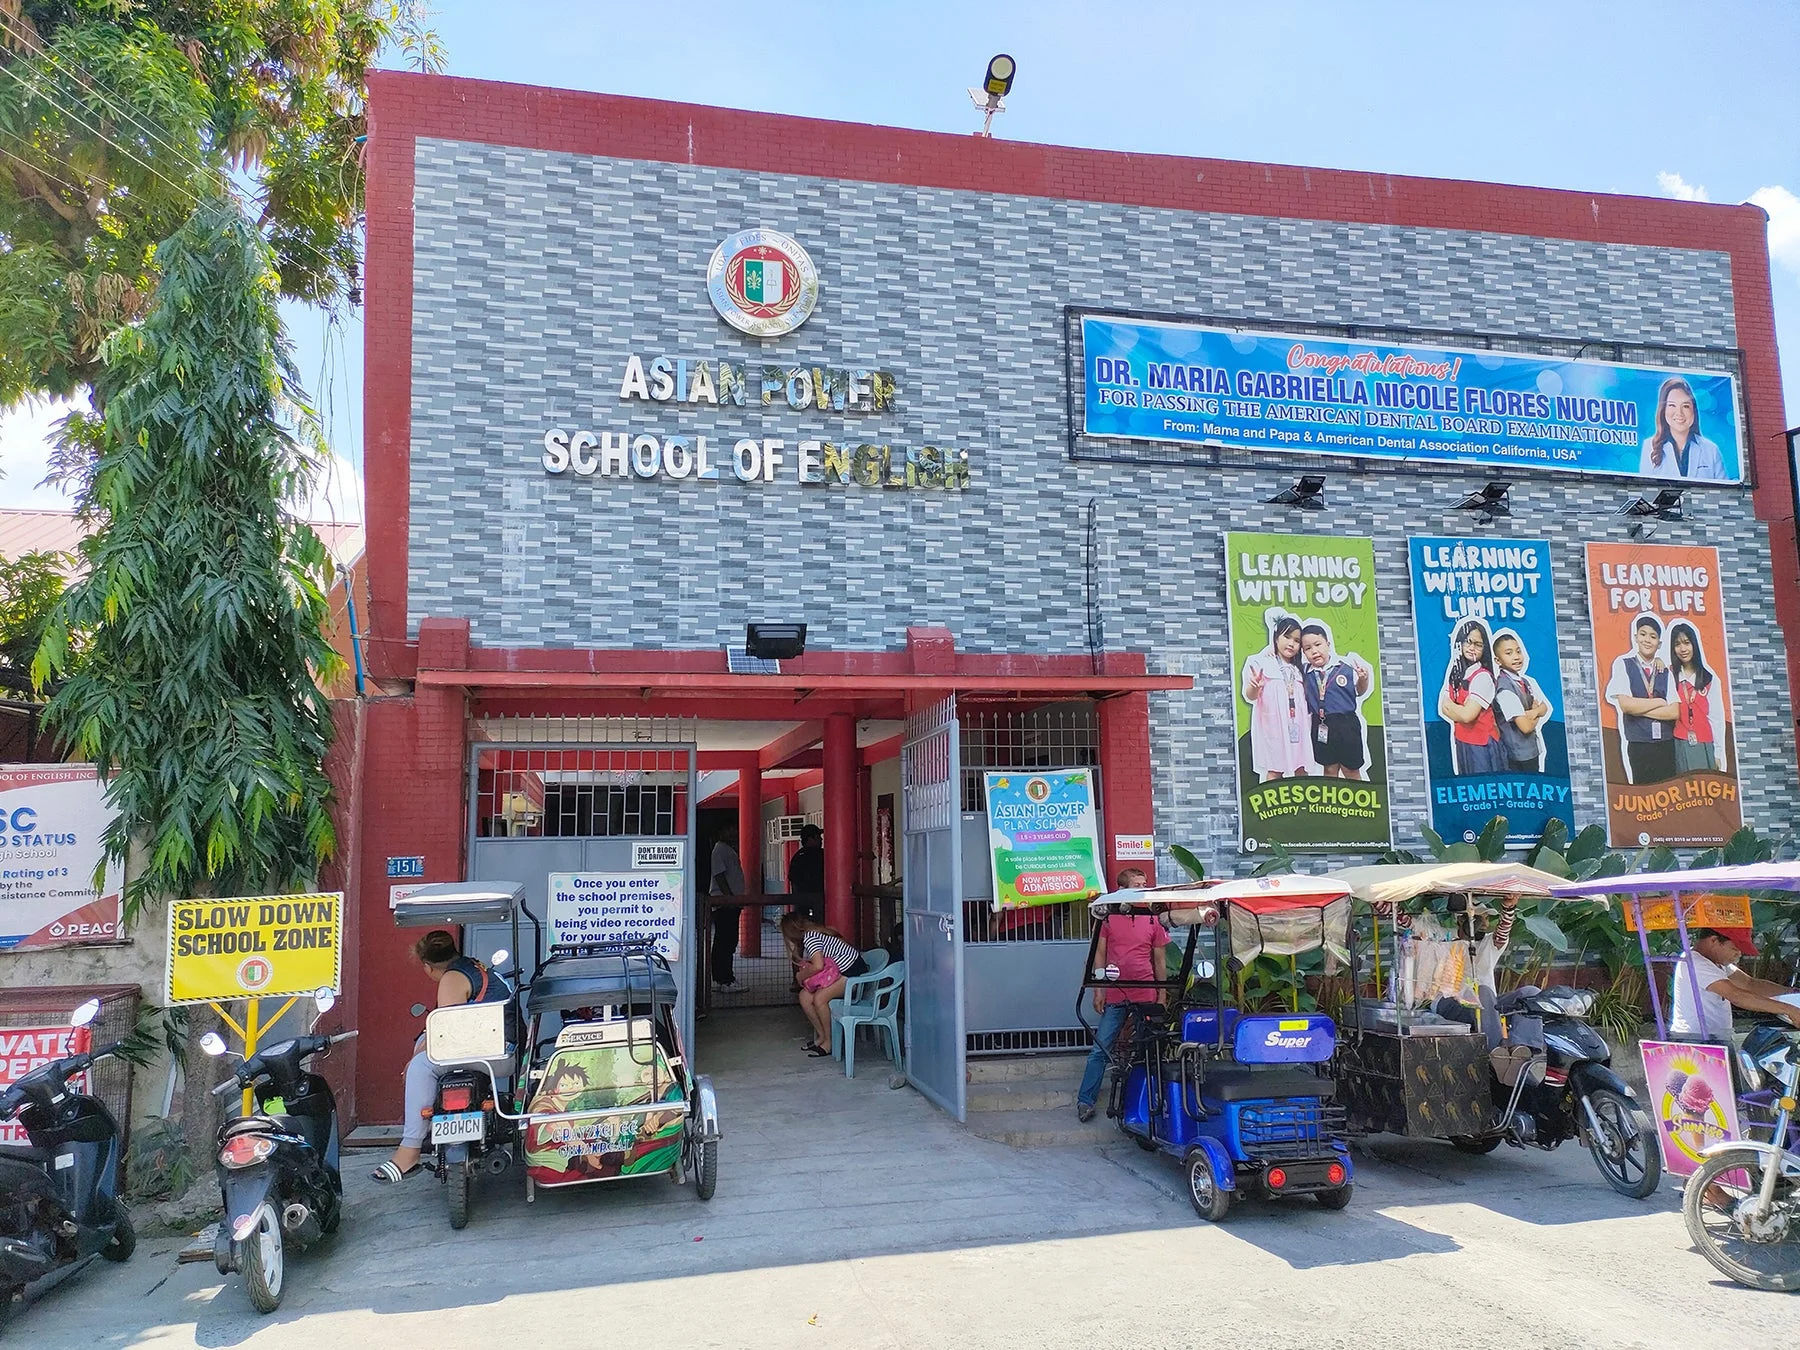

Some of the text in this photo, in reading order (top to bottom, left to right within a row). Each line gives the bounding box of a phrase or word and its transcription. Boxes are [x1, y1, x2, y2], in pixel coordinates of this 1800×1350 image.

[1287, 344, 1462, 381] Congratulations!
[620, 355, 899, 413] ASIAN POWER
[1096, 357, 1637, 426] DR. MARIA GABRIELLA NICOLE FLORES NUCUM
[1100, 389, 1638, 446] FOR PASSING THE AMERICAN DENTAL BOARD EXAMINATION!!!
[1163, 419, 1200, 434] From:
[1203, 423, 1240, 438] Mama
[1243, 428, 1266, 440] and
[1269, 428, 1300, 443] Papa
[1303, 431, 1313, 443] &
[1316, 432, 1374, 447] American
[1377, 436, 1416, 450] Dental
[1419, 439, 1490, 454] Association
[1492, 443, 1550, 460] California,
[541, 429, 969, 490] SCHOOL OF ENGLISH
[1241, 552, 1361, 579] LEARNING
[1423, 545, 1538, 570] LEARNING
[1423, 571, 1541, 595] WITHOUT
[1601, 563, 1709, 588] LEARNING
[1237, 579, 1367, 606] WITH JOY
[1610, 588, 1706, 612] FOR LIFE
[1443, 595, 1526, 619] LIMITS
[16, 773, 29, 781] OF
[1249, 784, 1382, 814] PRESCHOOL
[1436, 782, 1570, 804] ELEMENTARY
[1613, 779, 1736, 813] JUNIOR HIGH
[995, 803, 1087, 818] ASIAN POWER
[1258, 805, 1300, 821] Nursery
[1308, 804, 1376, 819] Kindergarten
[1462, 802, 1492, 812] Grade
[1505, 799, 1535, 809] Grade
[1537, 801, 1544, 810] 6
[1636, 811, 1663, 822] Grade
[1662, 807, 1668, 816] 7
[1675, 799, 1702, 812] Grade
[1703, 797, 1713, 807] 10
[1003, 818, 1081, 831] PLAY SCHOOL
[11, 833, 77, 847] STATUS
[1117, 840, 1144, 849] Smile!
[15, 848, 58, 860] School
[637, 846, 677, 854] DON'T BLOCK
[637, 853, 678, 861] THE DRIVEWAY
[2, 867, 69, 880] Rating of 3
[396, 860, 416, 873] 151
[15, 881, 33, 889] the
[573, 878, 660, 892] Once you enter
[1021, 876, 1041, 885] NOW
[1041, 876, 1061, 884] OPEN
[1022, 882, 1080, 893] ADMISSION
[556, 890, 676, 903] the school premises,
[178, 901, 333, 931] SLOW DOWN
[578, 904, 654, 917] you permit to
[67, 922, 115, 937] PEAC
[554, 916, 676, 931] being video recorded
[177, 927, 333, 957] SCHOOL ZONE
[560, 929, 670, 944] for your safety and
[1264, 1031, 1312, 1049] Super
[435, 1118, 480, 1137] 280WCN
[1672, 1113, 1724, 1139] Sunrise
